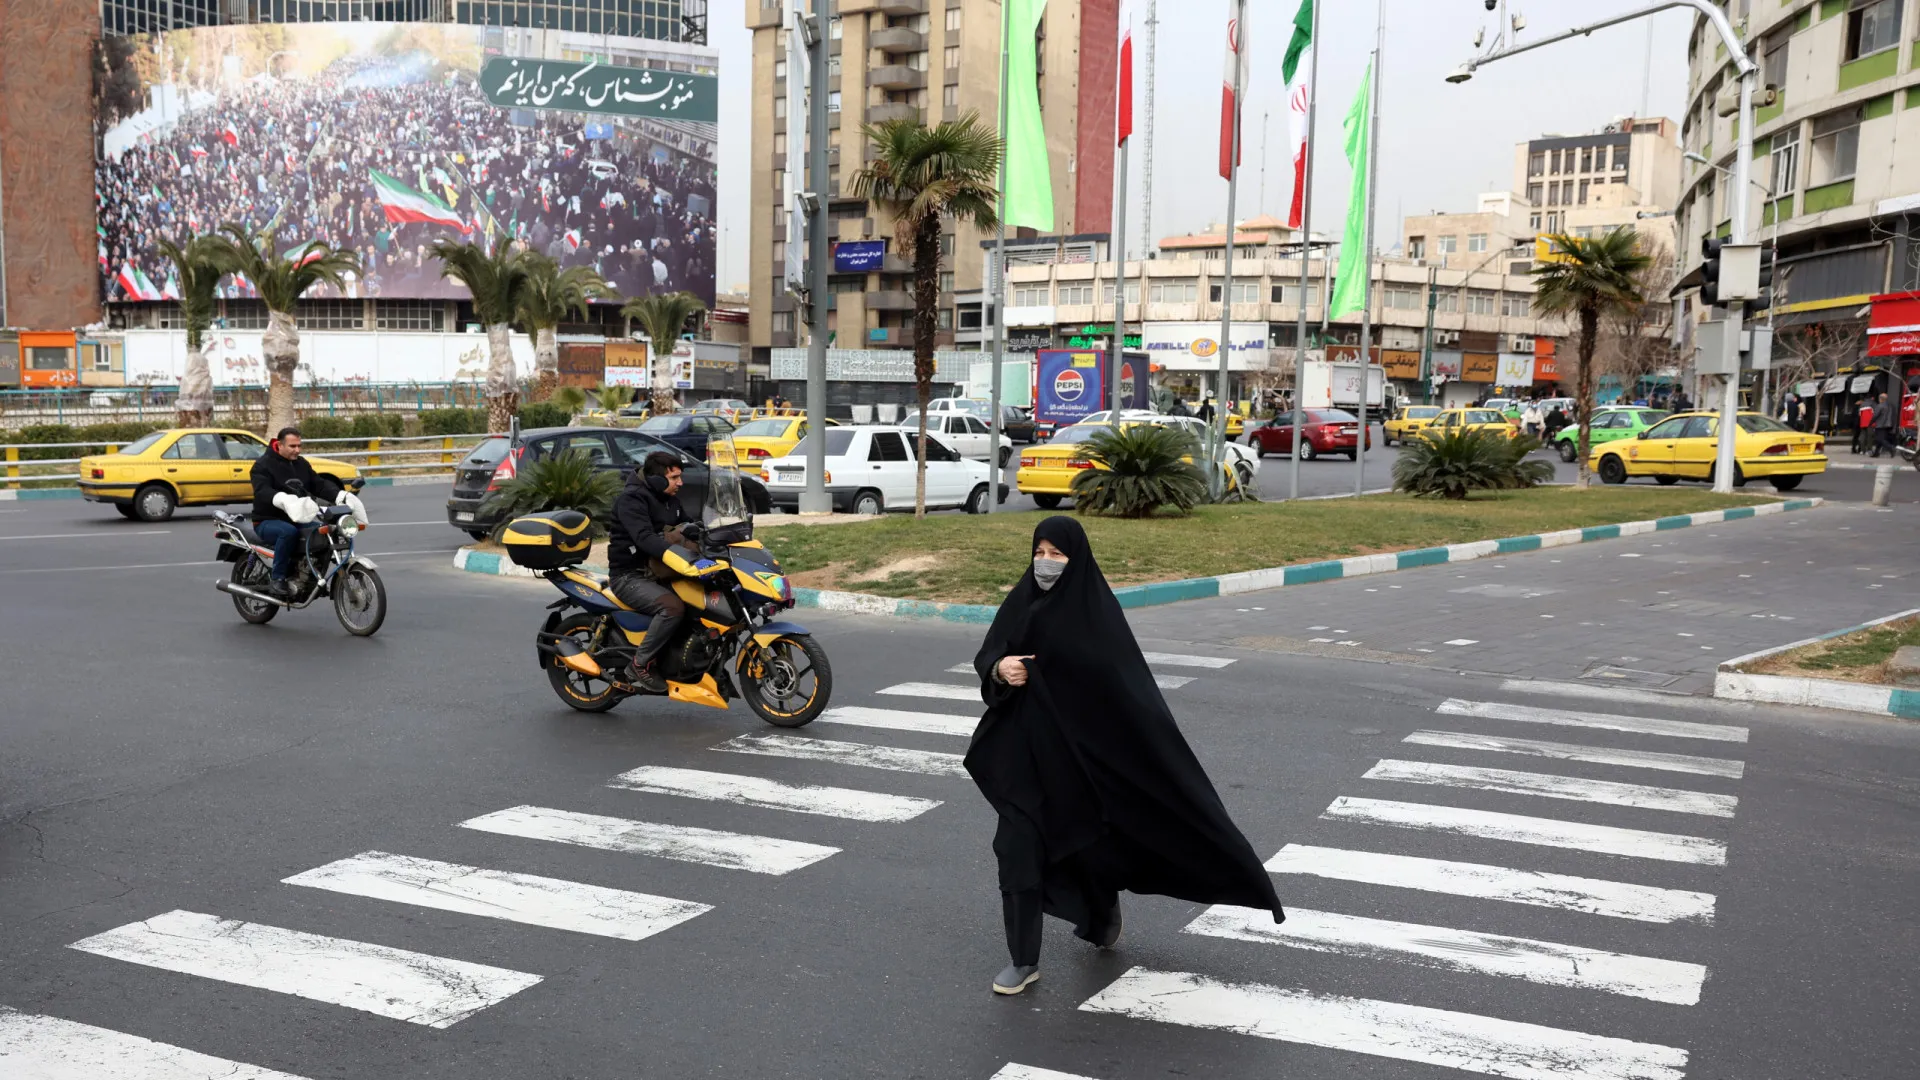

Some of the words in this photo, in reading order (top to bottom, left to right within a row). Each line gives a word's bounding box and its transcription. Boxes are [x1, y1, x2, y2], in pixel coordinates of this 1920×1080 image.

[531, 75, 566, 106] من
[561, 58, 598, 97] که
[1056, 381, 1082, 389] PEPSI
